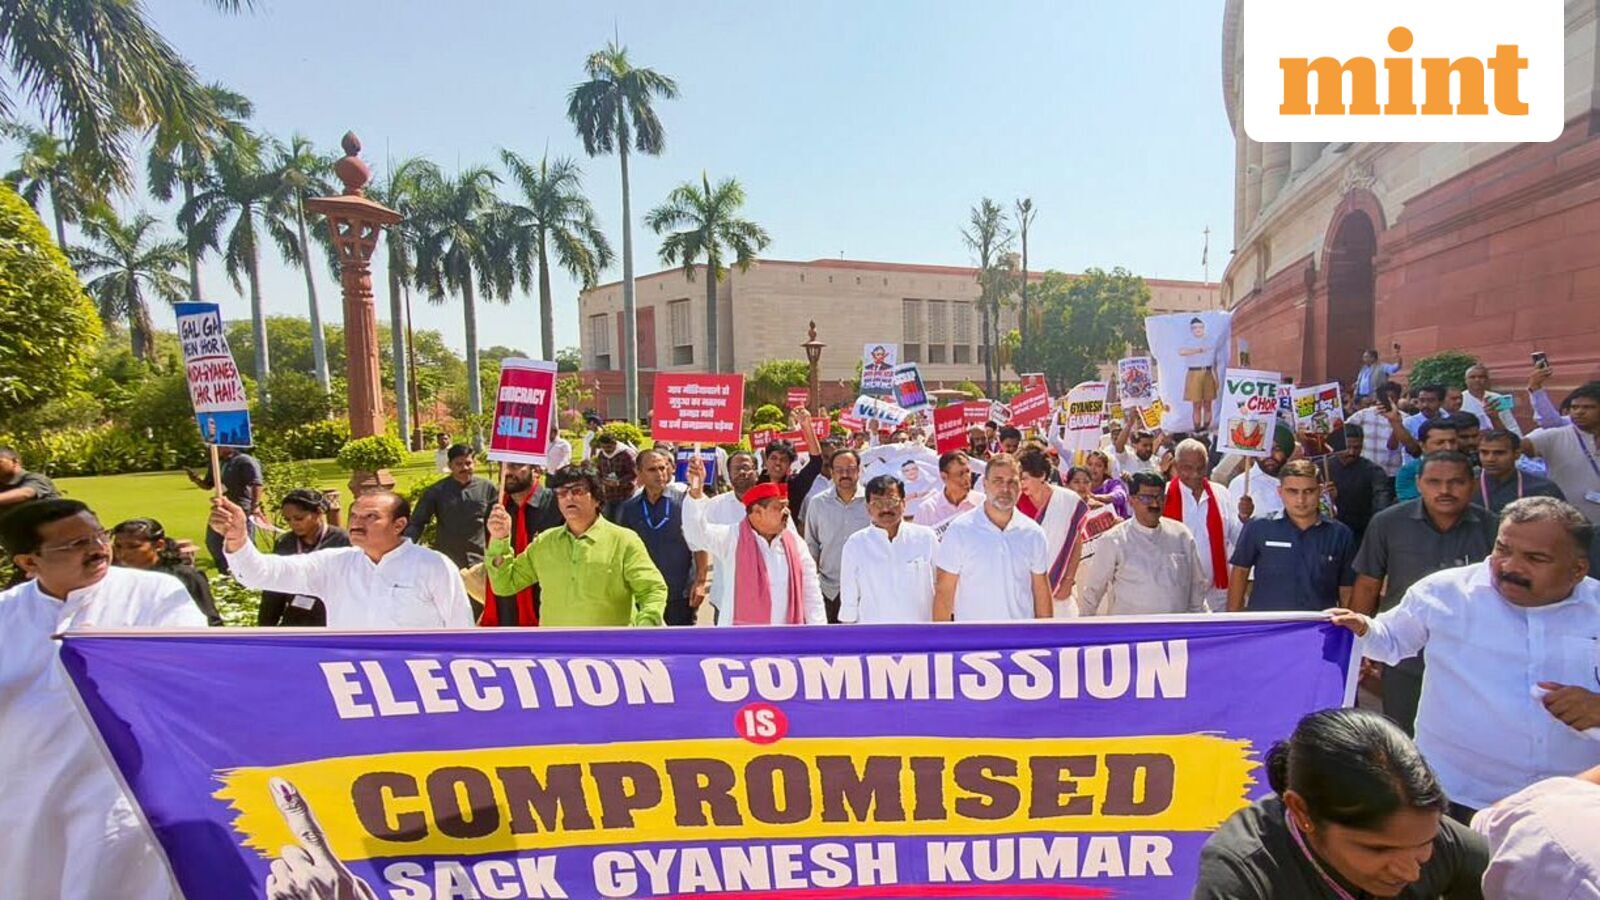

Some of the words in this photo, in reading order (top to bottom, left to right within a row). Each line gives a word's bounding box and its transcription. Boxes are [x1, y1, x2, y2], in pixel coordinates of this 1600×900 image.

[1227, 380, 1277, 397] VOTE
[1247, 396, 1277, 411] CHOR
[1070, 400, 1104, 415] GYANESH
[319, 658, 675, 719] ELECTION
[699, 639, 1189, 702] COMMISSION
[744, 708, 777, 738] IS
[350, 752, 1176, 843] COMPROMISED
[383, 855, 569, 900] SACK
[592, 842, 898, 896] GYANESH
[926, 835, 1174, 883] KUMAR
